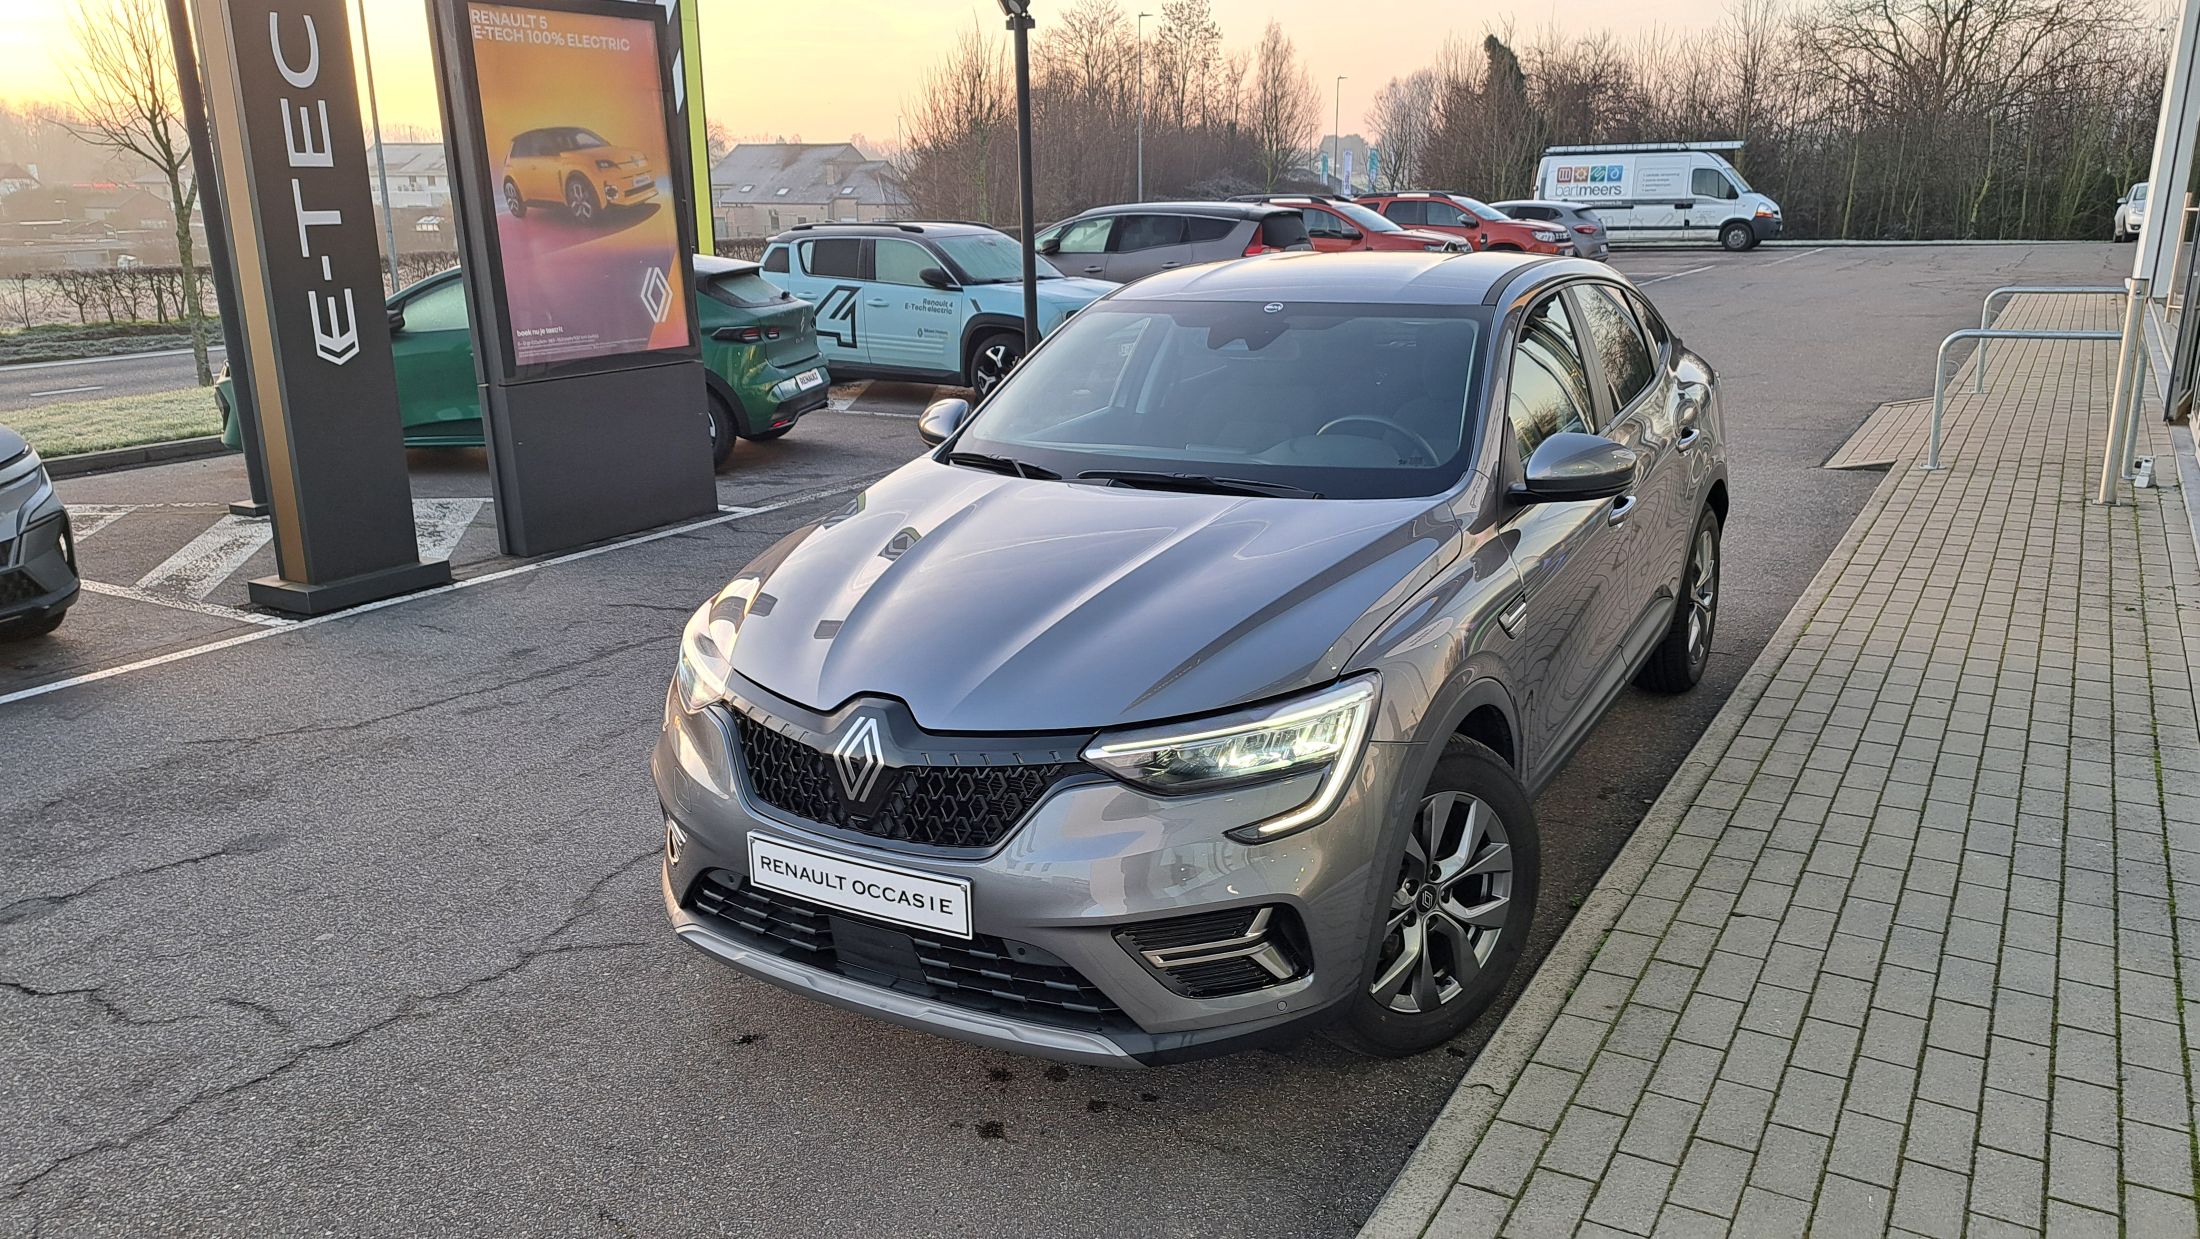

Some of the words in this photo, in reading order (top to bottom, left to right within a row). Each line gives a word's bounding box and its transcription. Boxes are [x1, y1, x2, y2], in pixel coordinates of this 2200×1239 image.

[470, 9, 537, 29] RENAULT
[539, 16, 549, 30] 5
[472, 25, 524, 43] E-TECH
[526, 30, 565, 46] 100%
[567, 34, 631, 51] ELECTRIC
[1555, 183, 1622, 197] bartmeers
[904, 302, 927, 312] E-Tech
[927, 305, 953, 315] electric
[922, 298, 948, 308] Renault
[760, 855, 847, 891] RENAULT
[851, 880, 954, 916] OCCASIE
